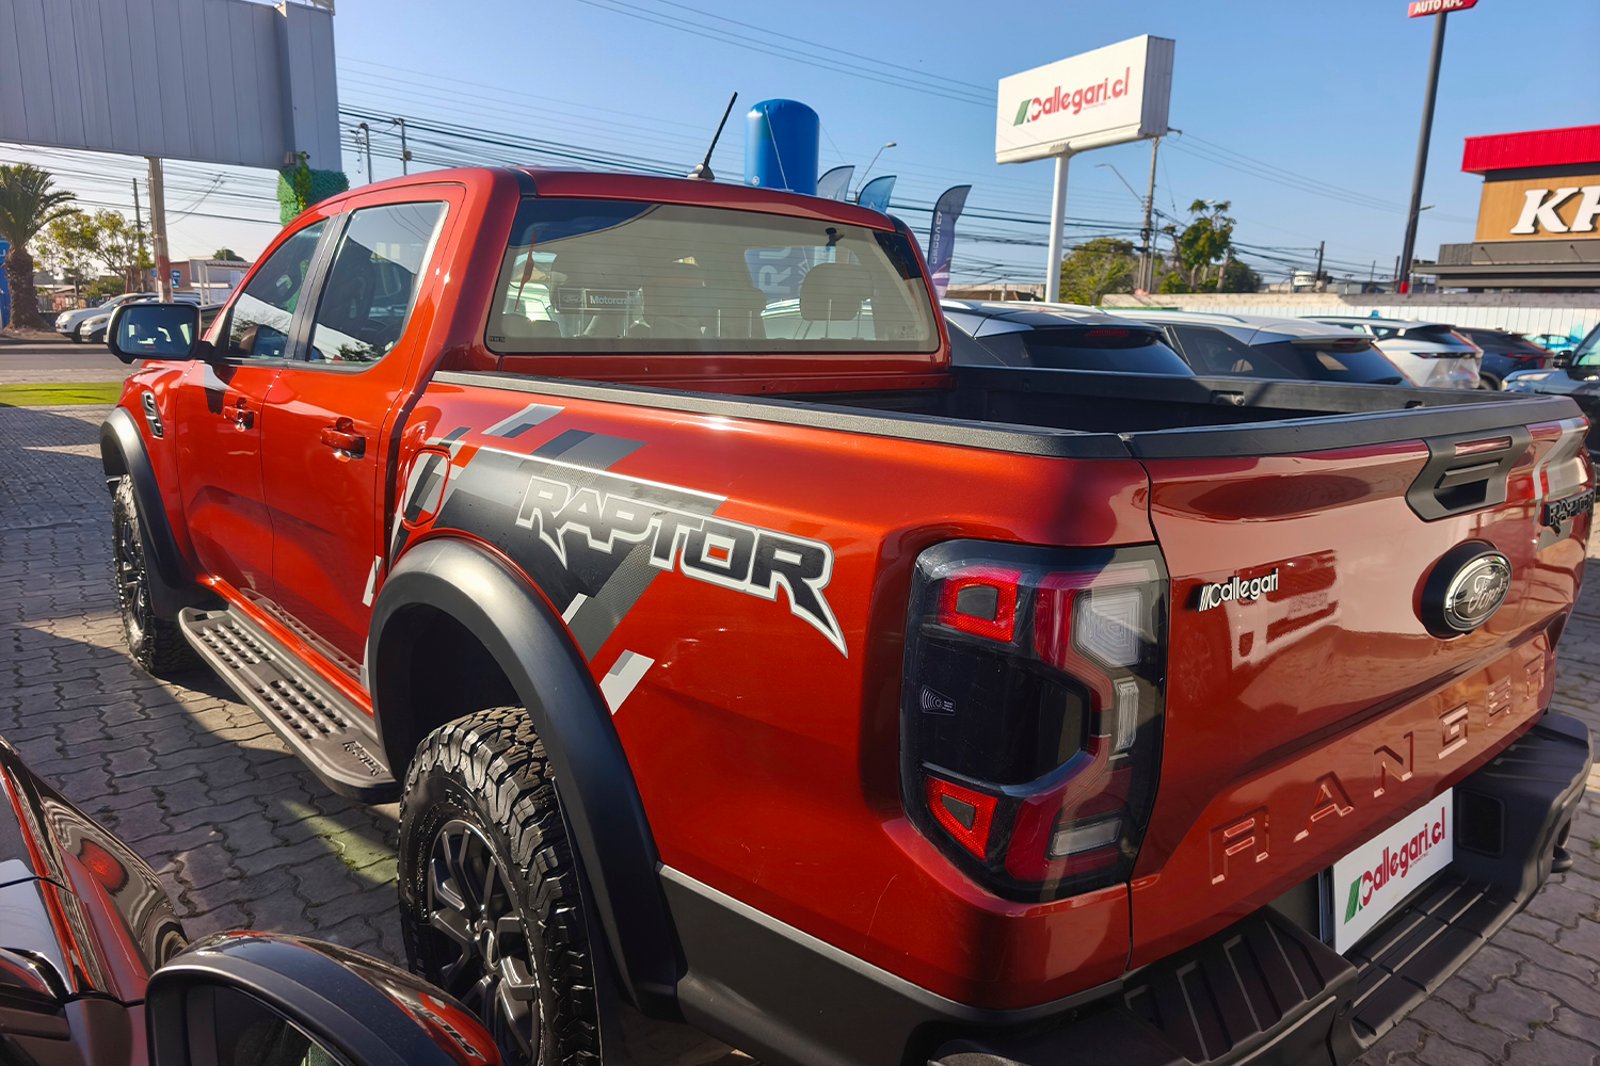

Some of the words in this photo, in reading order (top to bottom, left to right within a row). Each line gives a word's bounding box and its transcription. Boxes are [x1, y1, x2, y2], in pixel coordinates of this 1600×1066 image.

[1414, 0, 1441, 14] AUTO
[1030, 66, 1130, 122] Callegari.cl
[514, 475, 849, 660] RAPTOR
[1210, 567, 1279, 608] Callegari
[1466, 571, 1505, 614] Ford
[1208, 650, 1547, 885] RANGER
[1361, 805, 1446, 907] Callegari.cl
